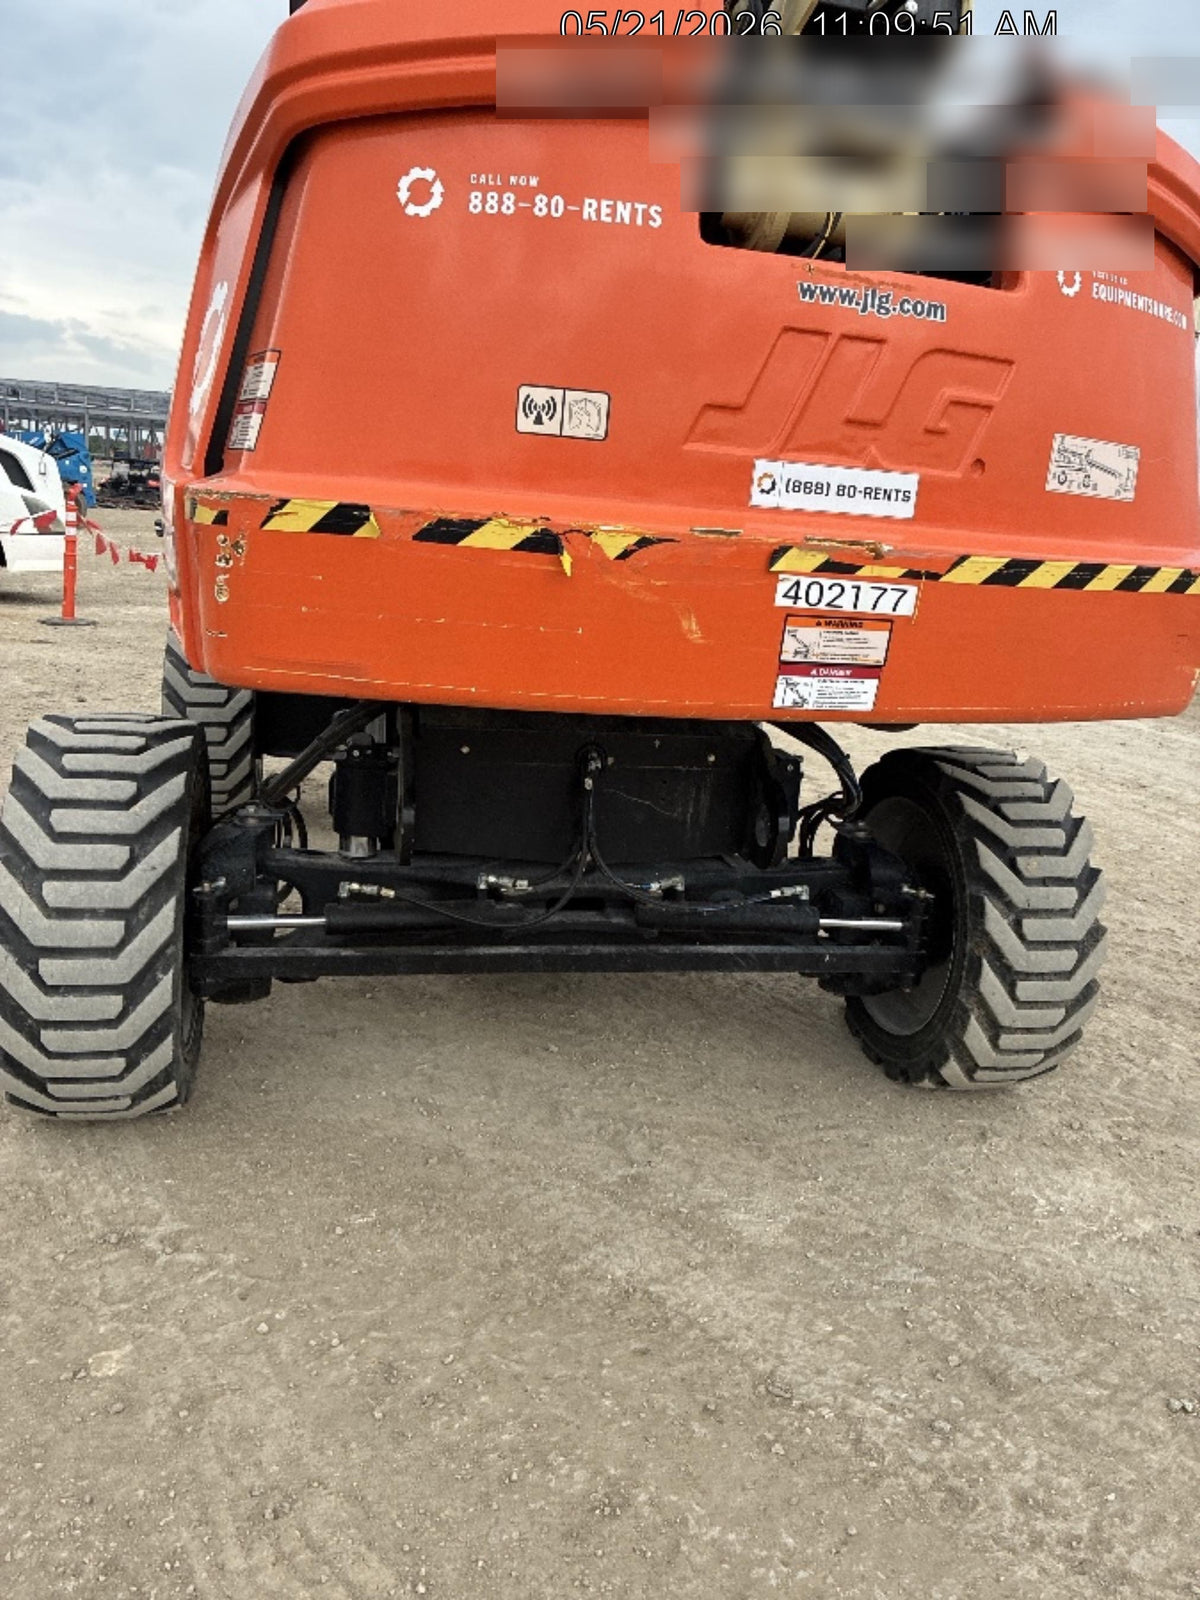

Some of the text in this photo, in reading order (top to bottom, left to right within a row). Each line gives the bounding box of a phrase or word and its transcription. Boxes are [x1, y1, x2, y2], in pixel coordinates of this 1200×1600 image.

[470, 173, 540, 187] CALL NOW
[468, 191, 663, 229] 888-80-RENTS
[798, 281, 946, 322] www.jlg.com
[682, 326, 1016, 478] JLG
[785, 477, 912, 503] (888) 80-RENTS
[781, 579, 908, 612] 402177
